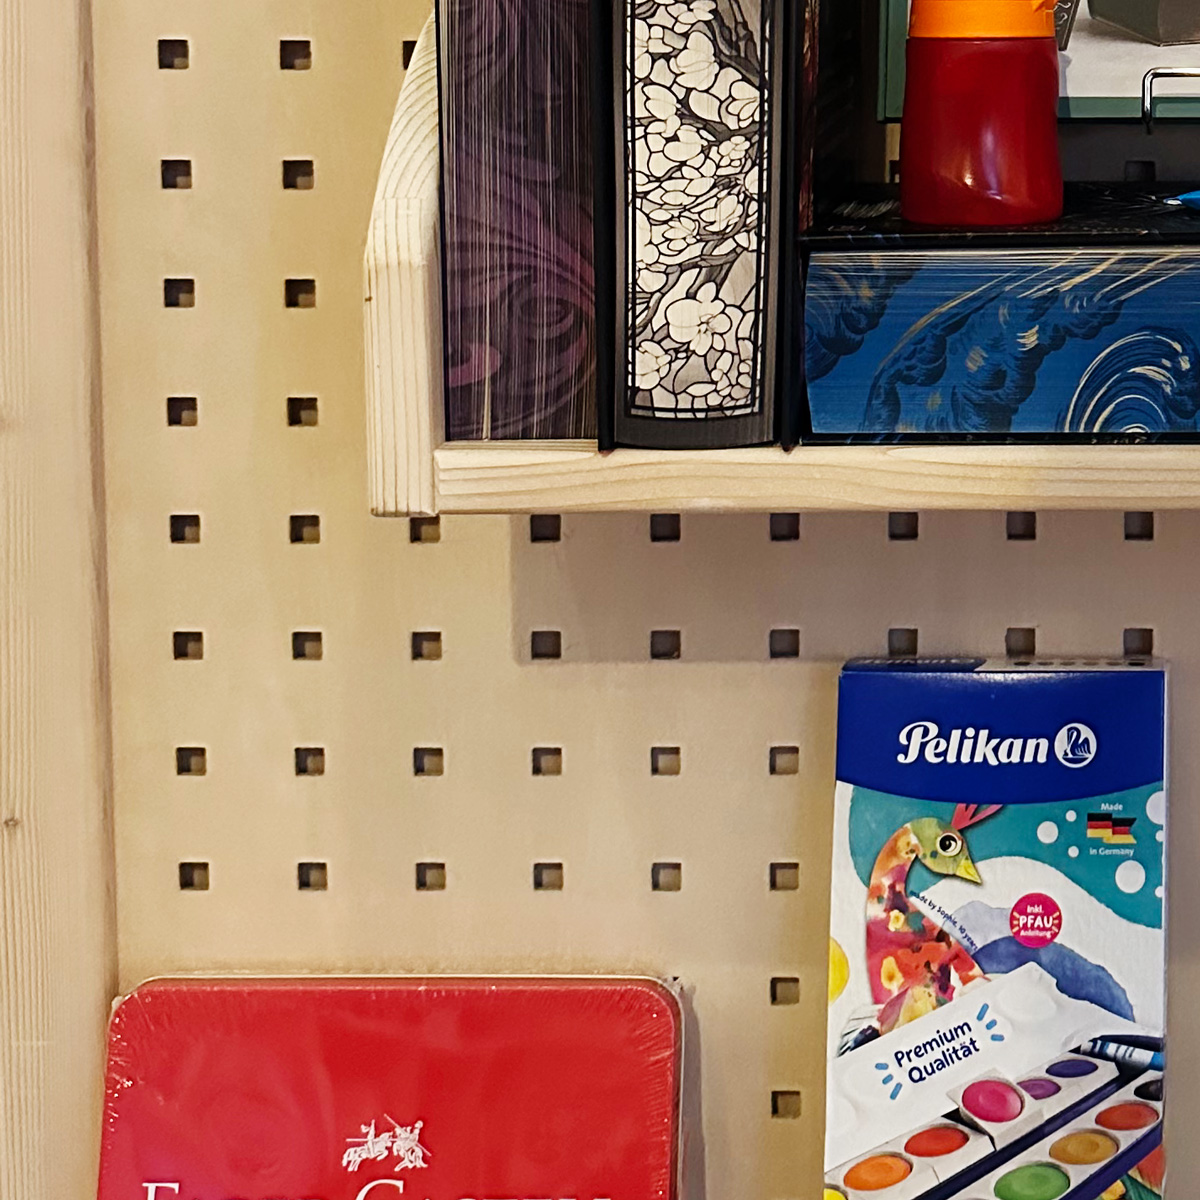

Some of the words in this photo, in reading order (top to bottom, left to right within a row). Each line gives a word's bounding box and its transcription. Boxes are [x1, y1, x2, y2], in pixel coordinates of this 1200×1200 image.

[897, 721, 1050, 766] Pelikan
[1100, 802, 1123, 811] Made
[1098, 847, 1135, 857] Germany
[928, 900, 937, 910] by
[1026, 904, 1044, 913] Inkl.
[1019, 915, 1053, 928] PFAU
[894, 1021, 972, 1068] Premium
[908, 1037, 980, 1084] Qualität
